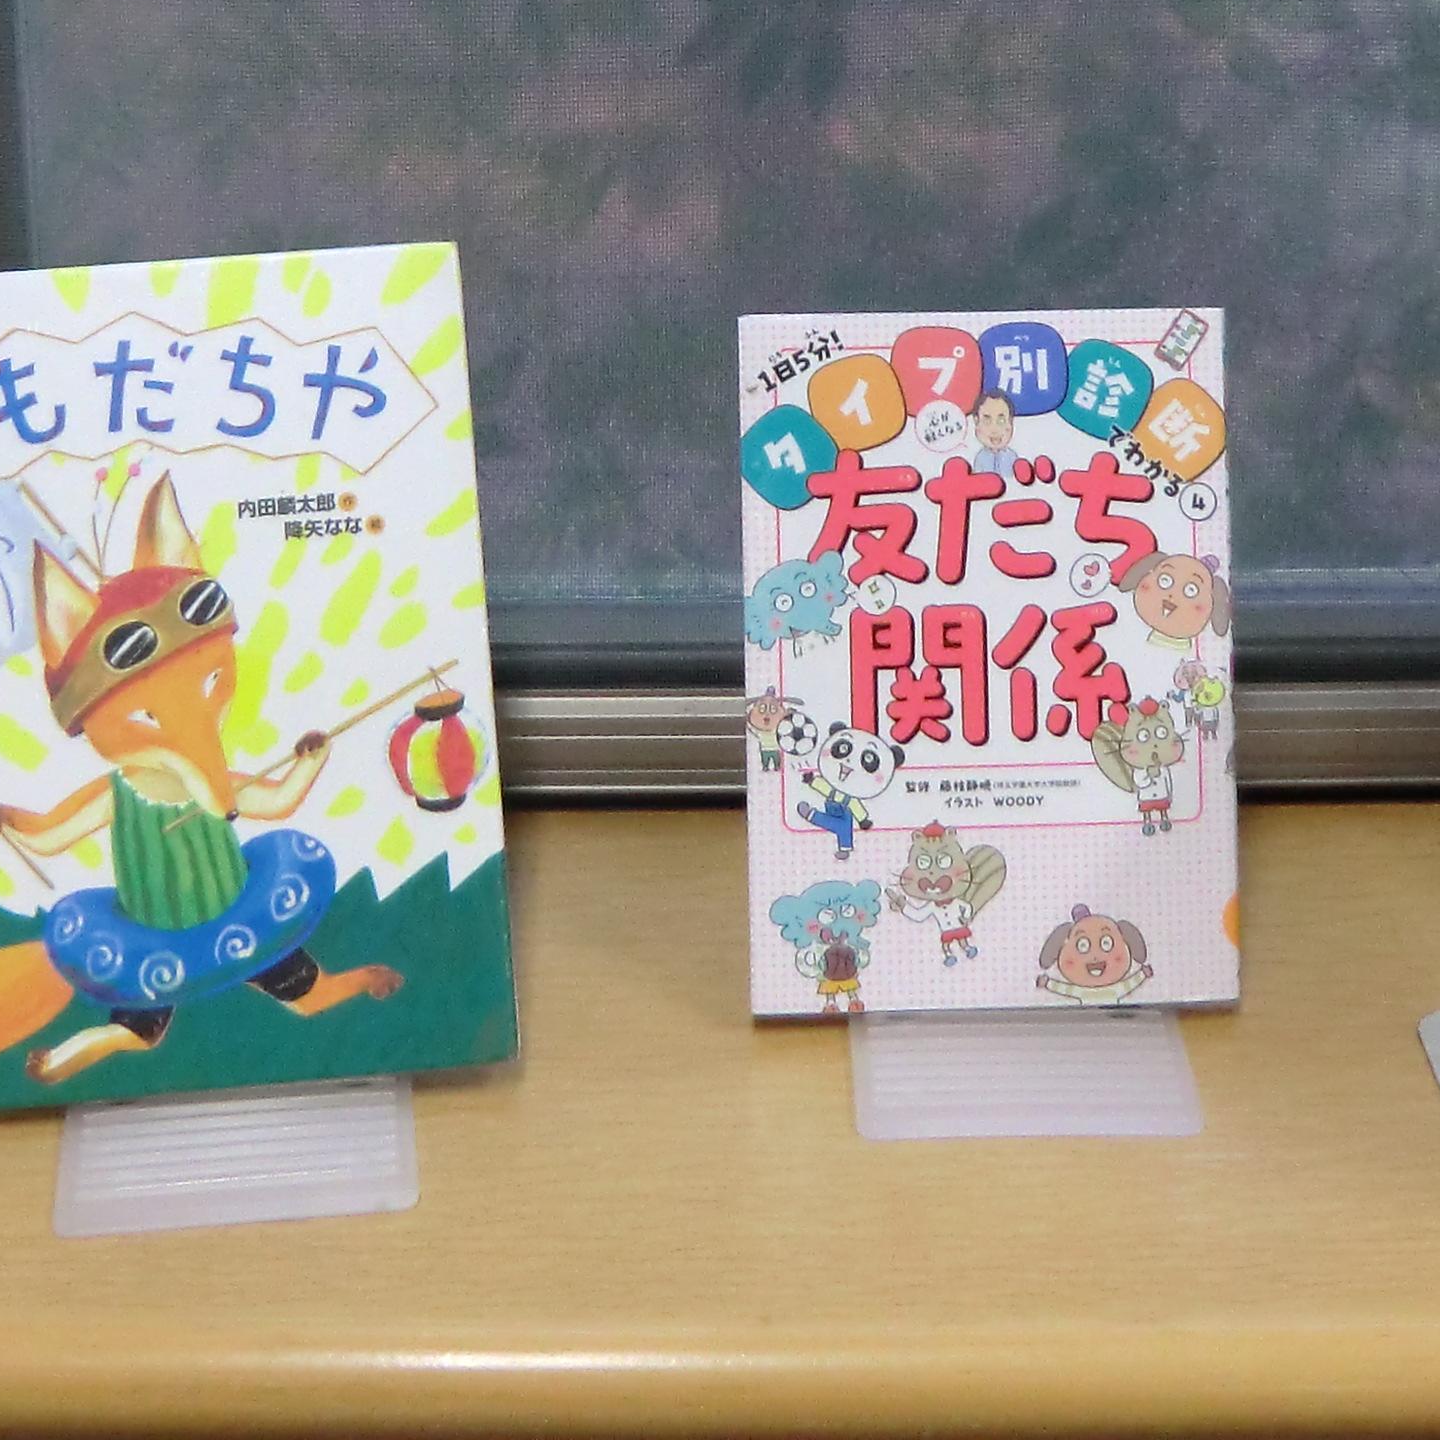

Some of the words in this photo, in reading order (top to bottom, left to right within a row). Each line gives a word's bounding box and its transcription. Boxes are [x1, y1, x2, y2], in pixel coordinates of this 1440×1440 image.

[1106, 425, 1185, 497] でわかる
[237, 491, 336, 519] 内田麟太郎
[283, 515, 363, 541] 降矢なな
[805, 448, 1160, 587] 友だち
[849, 603, 1131, 746] 関係
[944, 796, 984, 809] イラスト
[992, 794, 1045, 808] WOODY
